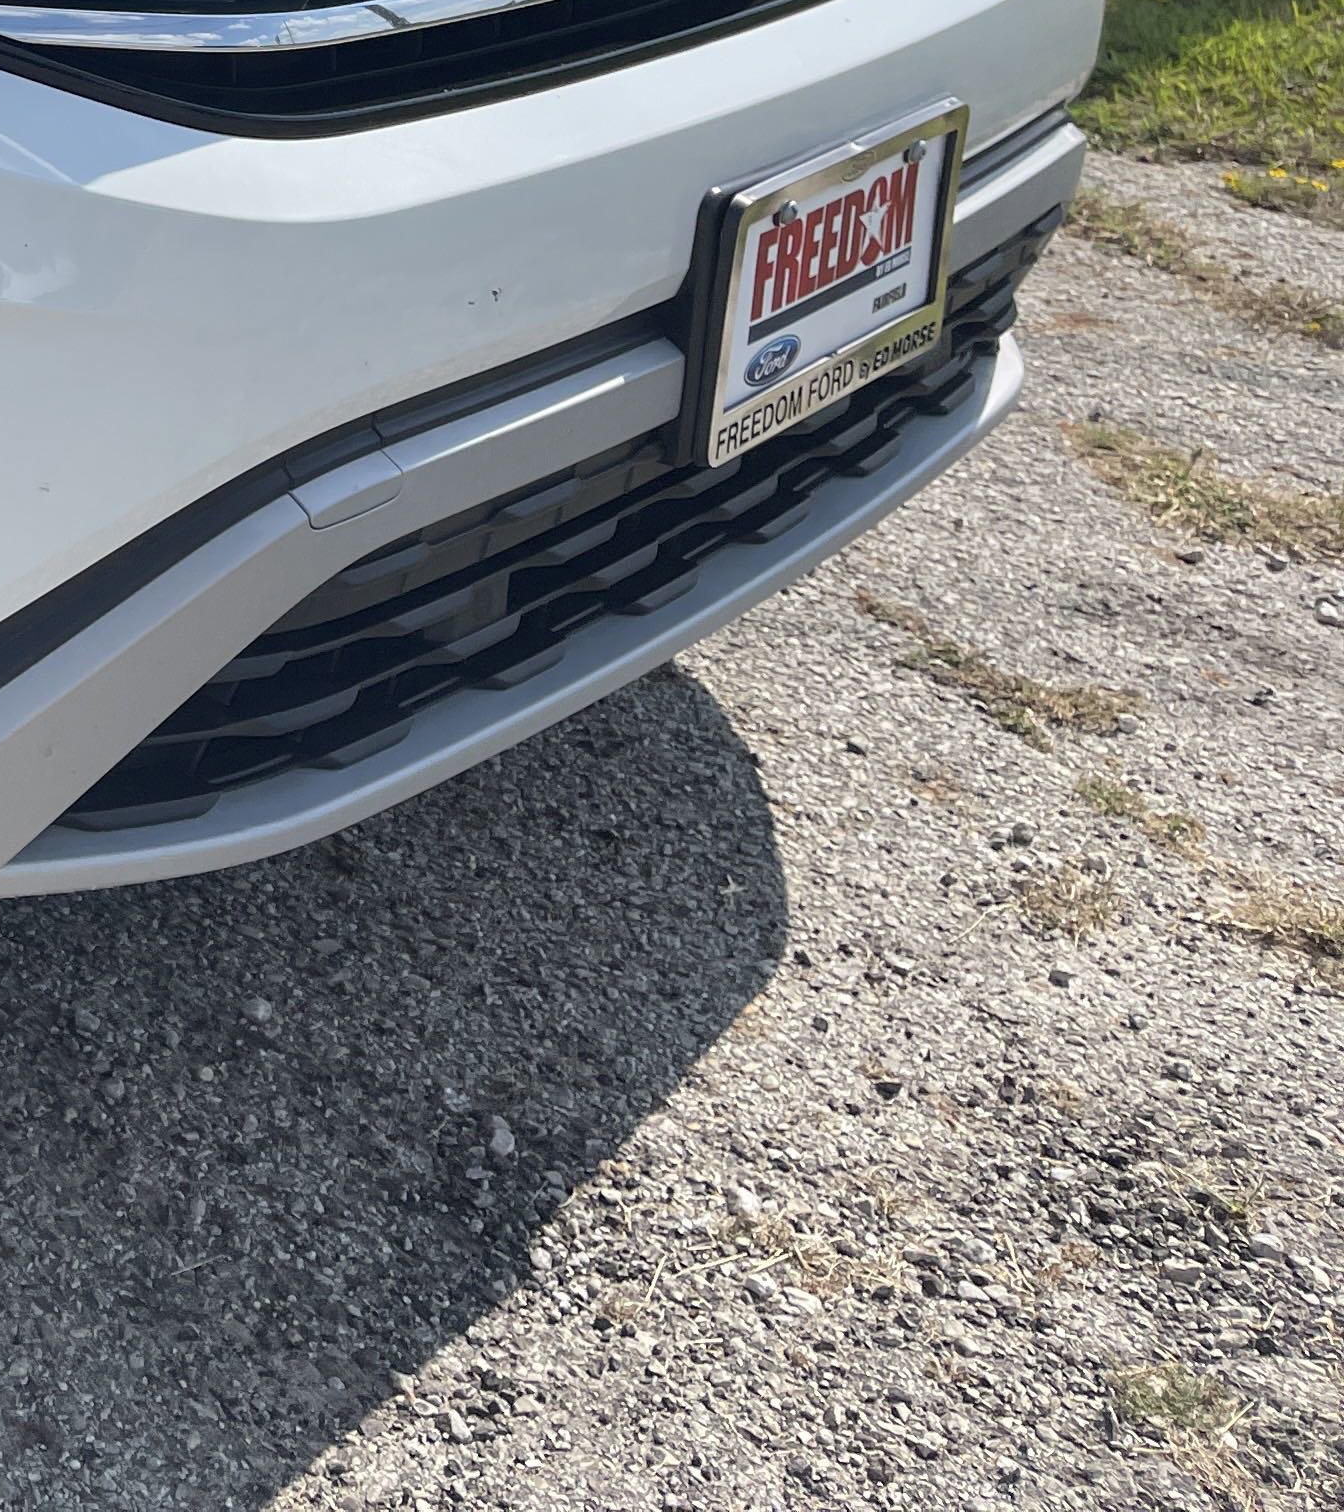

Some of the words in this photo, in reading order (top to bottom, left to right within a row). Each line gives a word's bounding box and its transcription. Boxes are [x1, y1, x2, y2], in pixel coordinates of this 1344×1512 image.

[750, 162, 919, 322] FREEDOM
[714, 384, 803, 460] FREEDOM
[807, 359, 854, 409] FORD
[890, 321, 937, 362] MORSE
[754, 343, 793, 380] Ford
